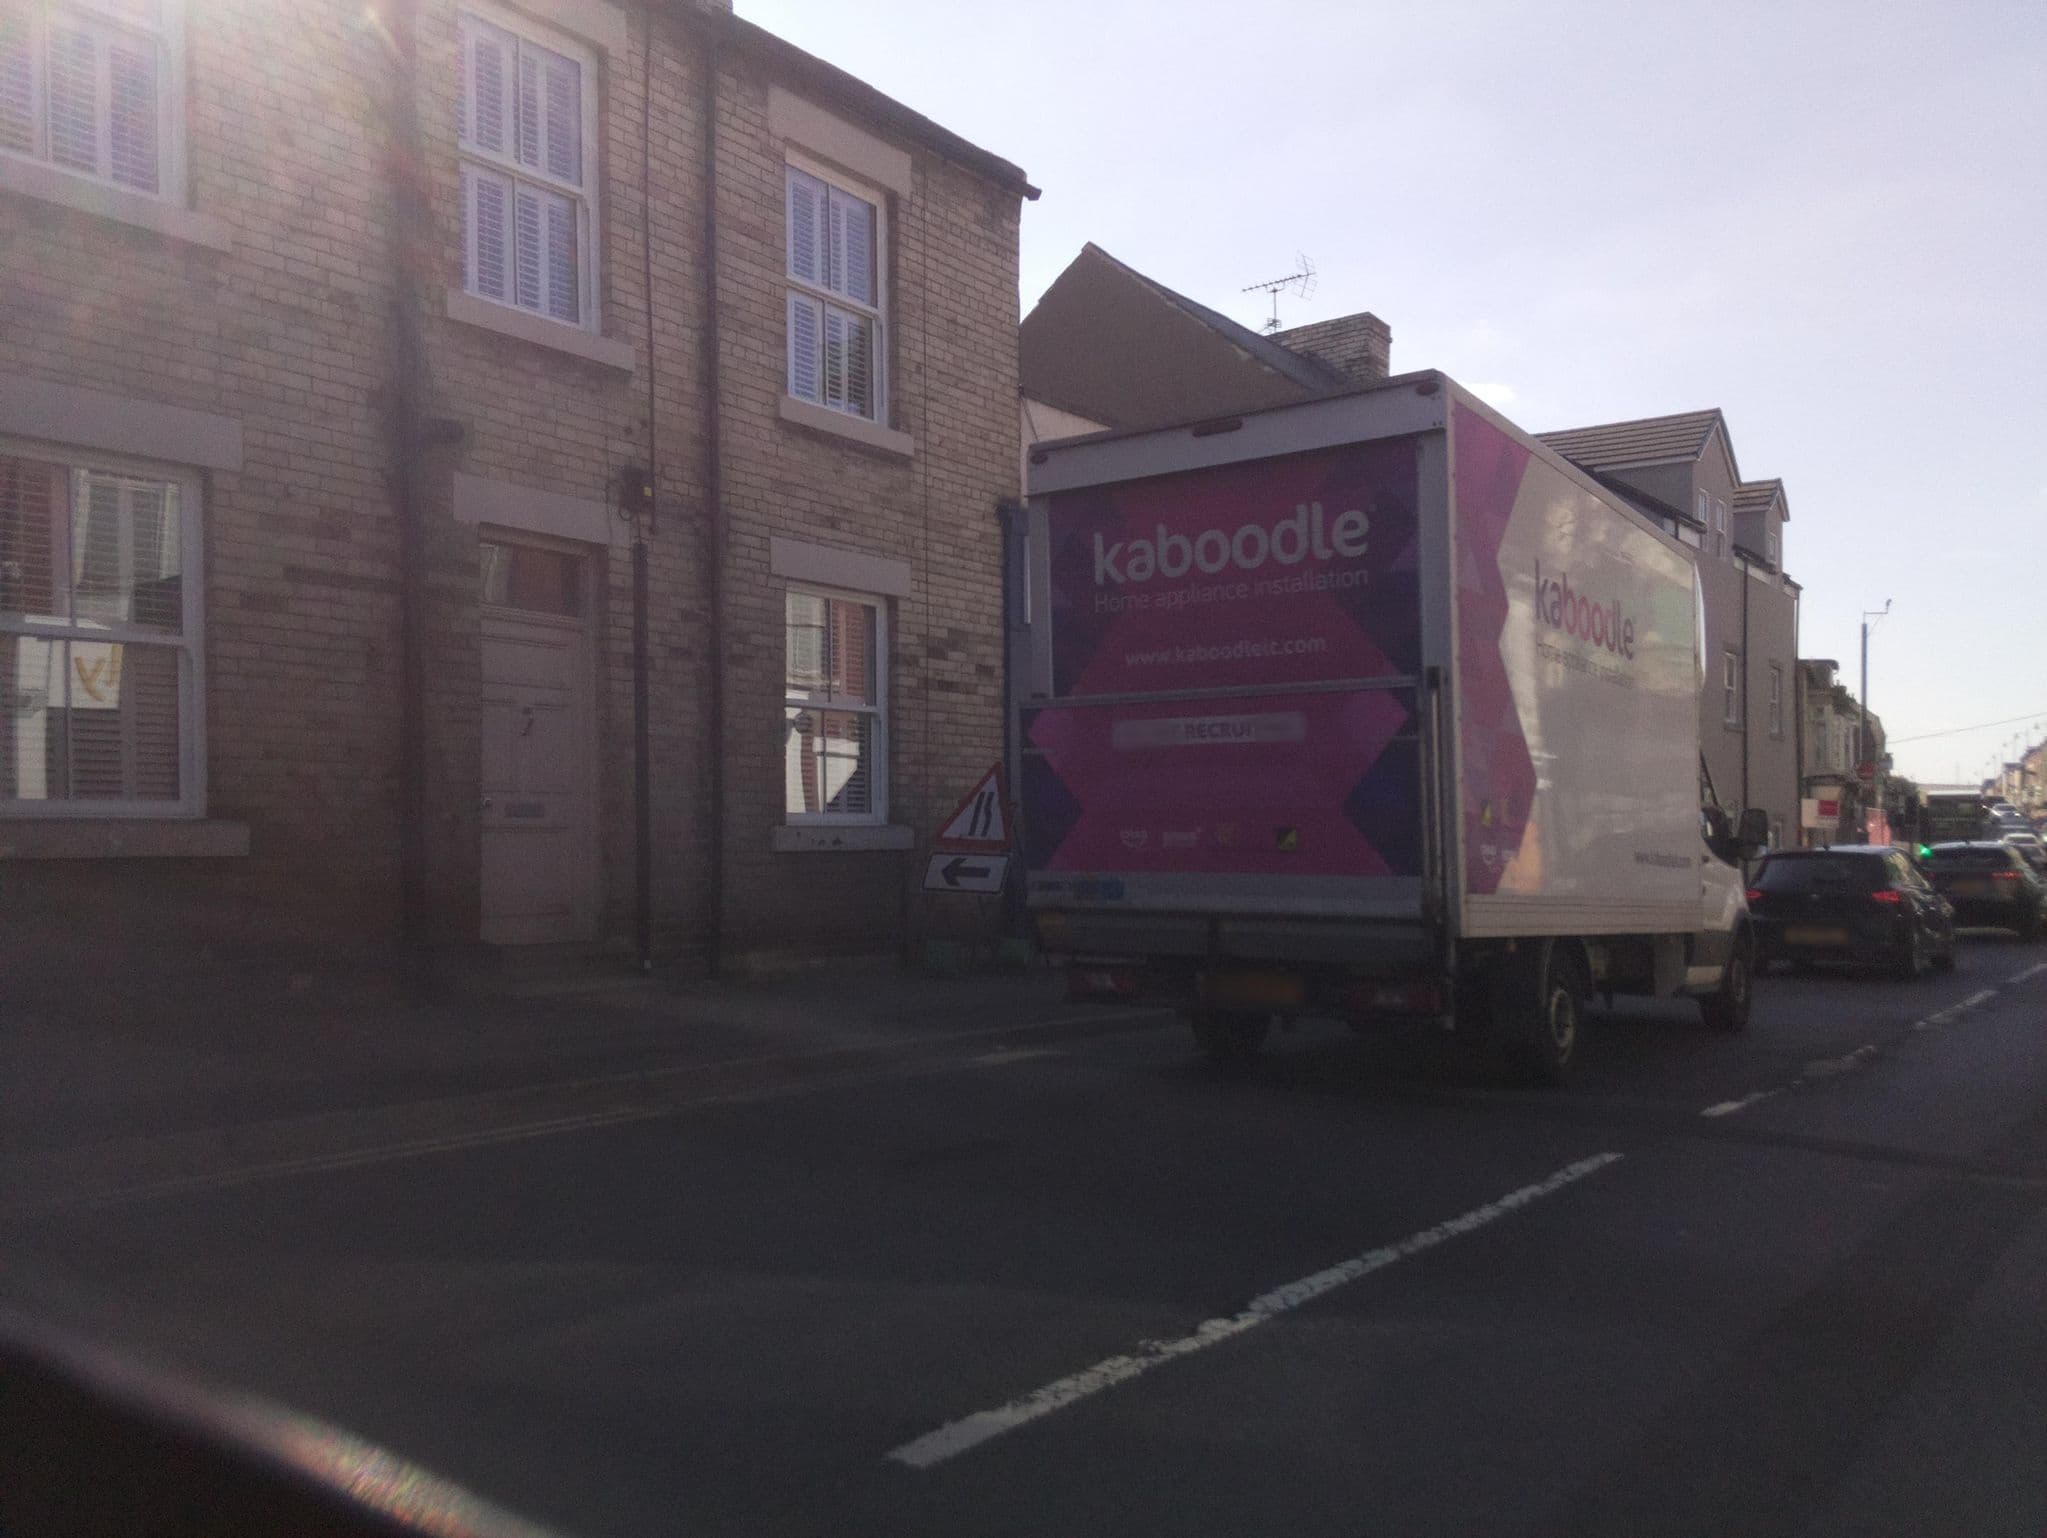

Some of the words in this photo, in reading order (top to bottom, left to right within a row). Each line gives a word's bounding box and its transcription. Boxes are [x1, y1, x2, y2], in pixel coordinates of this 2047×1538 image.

[1093, 501, 1371, 587] kaboodle
[1094, 592, 1150, 614] Home
[1154, 582, 1249, 611] appliance
[1254, 567, 1369, 597] installation
[1535, 558, 1634, 661] kaboodle
